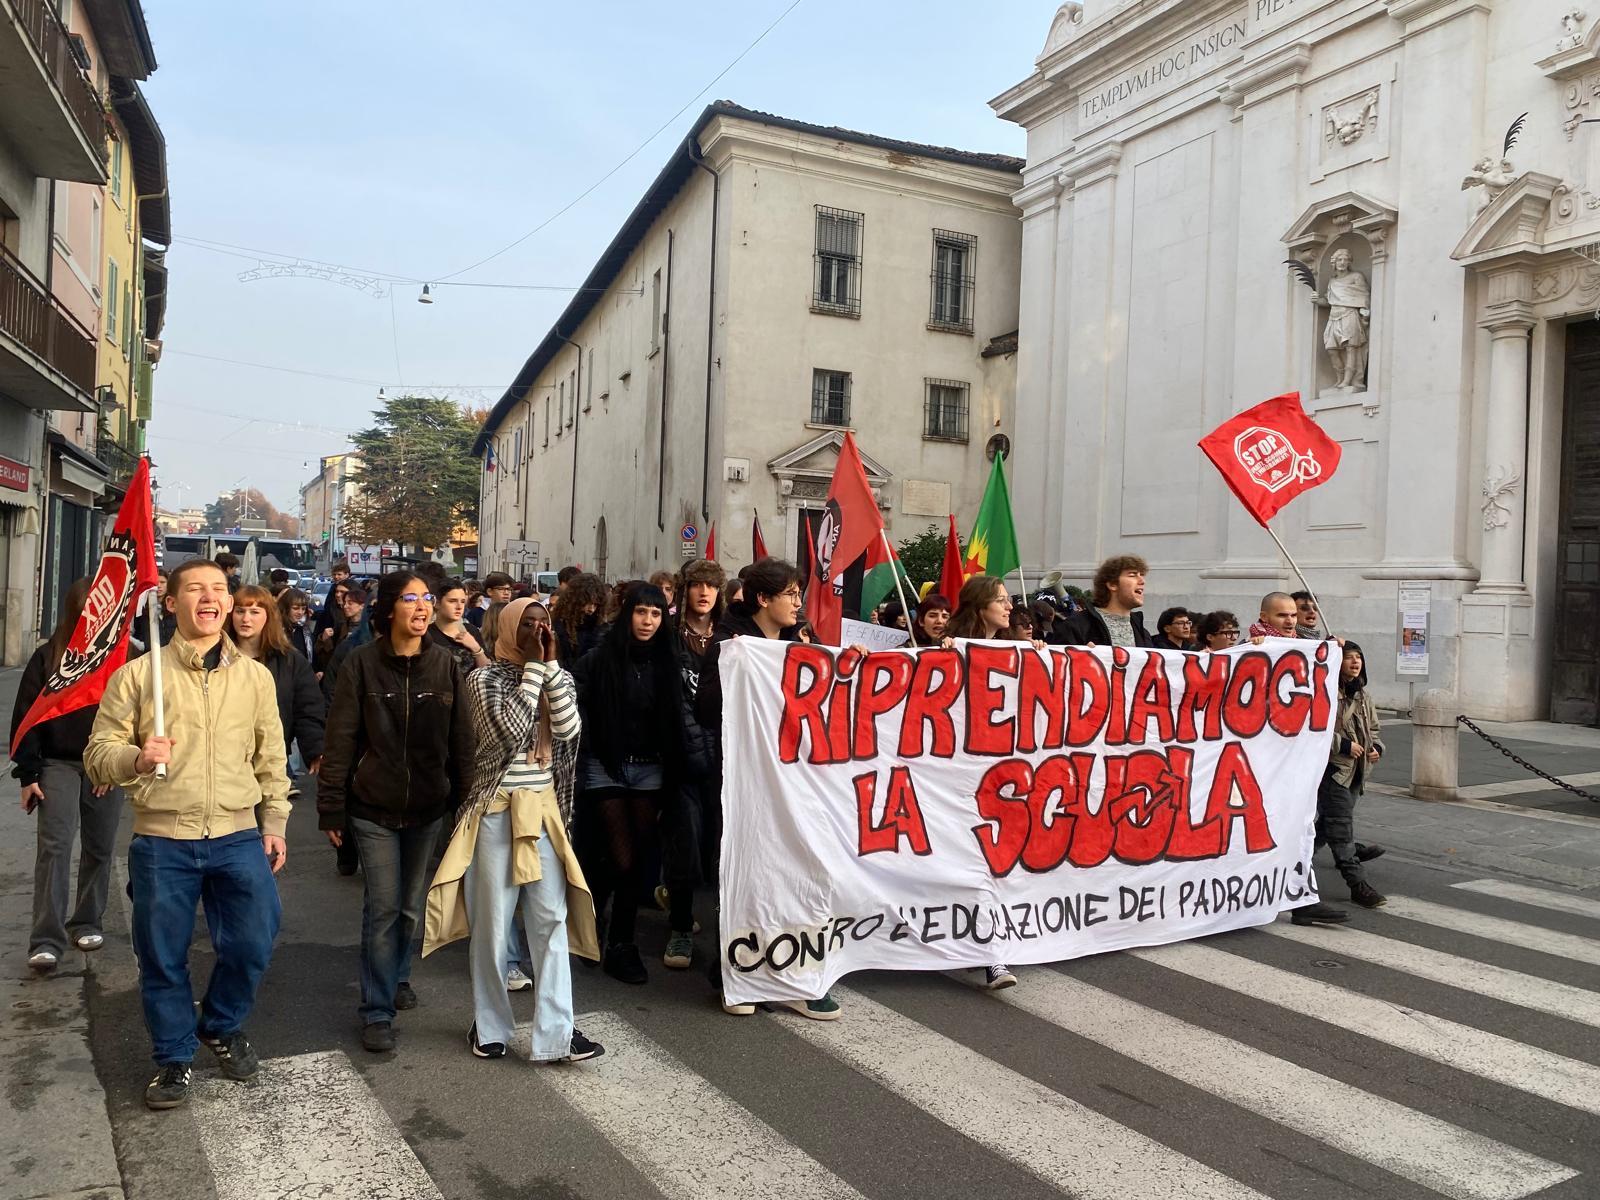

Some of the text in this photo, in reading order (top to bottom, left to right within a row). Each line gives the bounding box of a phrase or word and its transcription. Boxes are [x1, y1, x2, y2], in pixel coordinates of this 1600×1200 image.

[1256, 0, 1294, 21] PIE
[1083, 70, 1148, 118] TEMPLVM
[1151, 52, 1185, 85] HOC
[1241, 435, 1278, 466] STOP
[852, 741, 1277, 878] LA SCUOLA
[1119, 885, 1165, 922] DEI
